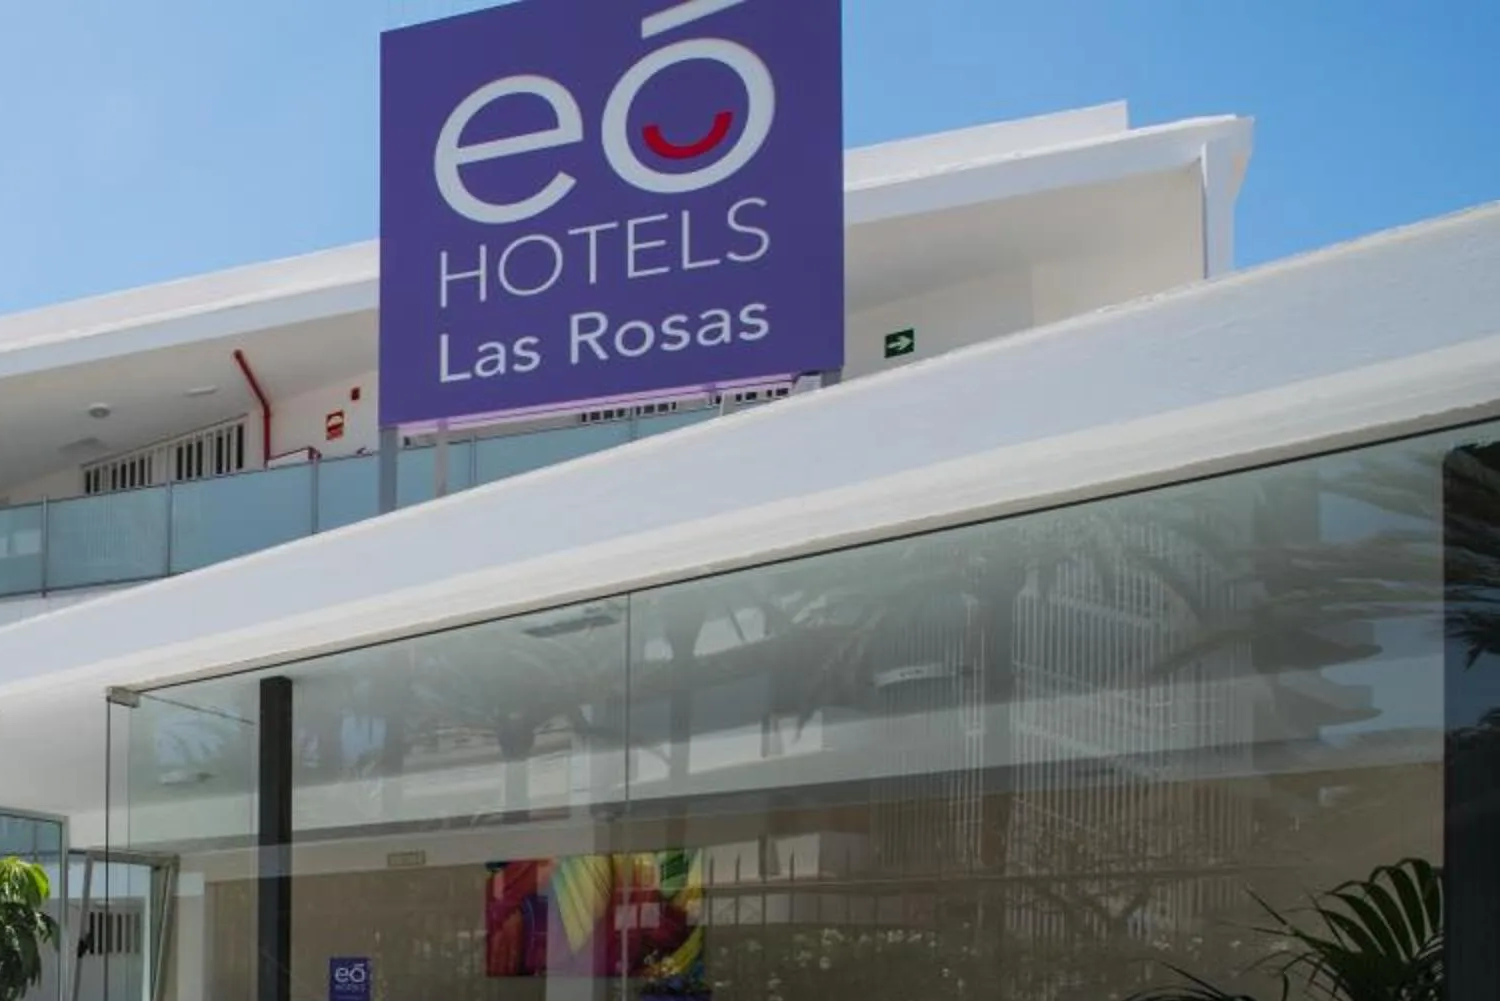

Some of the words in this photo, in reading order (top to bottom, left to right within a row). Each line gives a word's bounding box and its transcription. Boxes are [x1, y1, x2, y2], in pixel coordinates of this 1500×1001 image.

[440, 197, 771, 308] HOTELS
[439, 333, 541, 383] Las
[569, 302, 770, 364] Rosas
